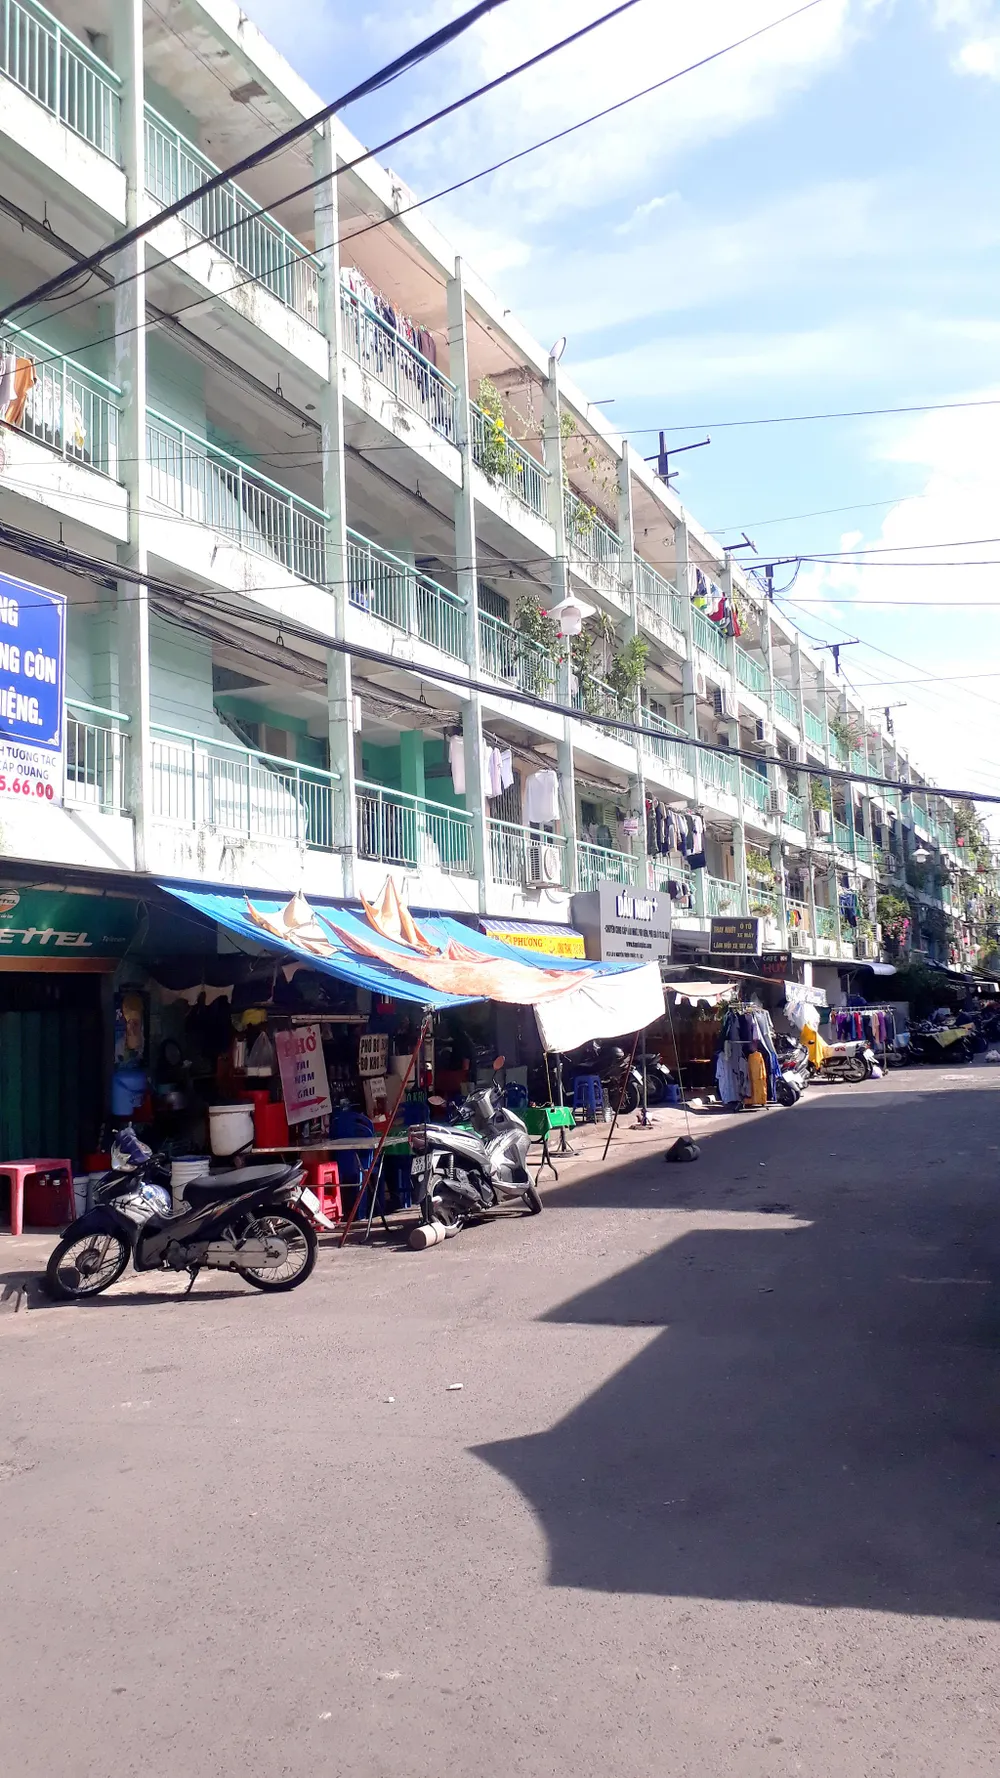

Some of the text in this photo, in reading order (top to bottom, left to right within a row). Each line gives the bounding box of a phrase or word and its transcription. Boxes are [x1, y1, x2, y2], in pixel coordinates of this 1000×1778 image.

[24, 647, 57, 685] CÒN
[0, 686, 43, 726] IỆNG.
[16, 764, 49, 781] QUANG
[513, 936, 543, 948] PHƯƠNG
[762, 962, 787, 973] HUY
[284, 1027, 317, 1057] PHỞ
